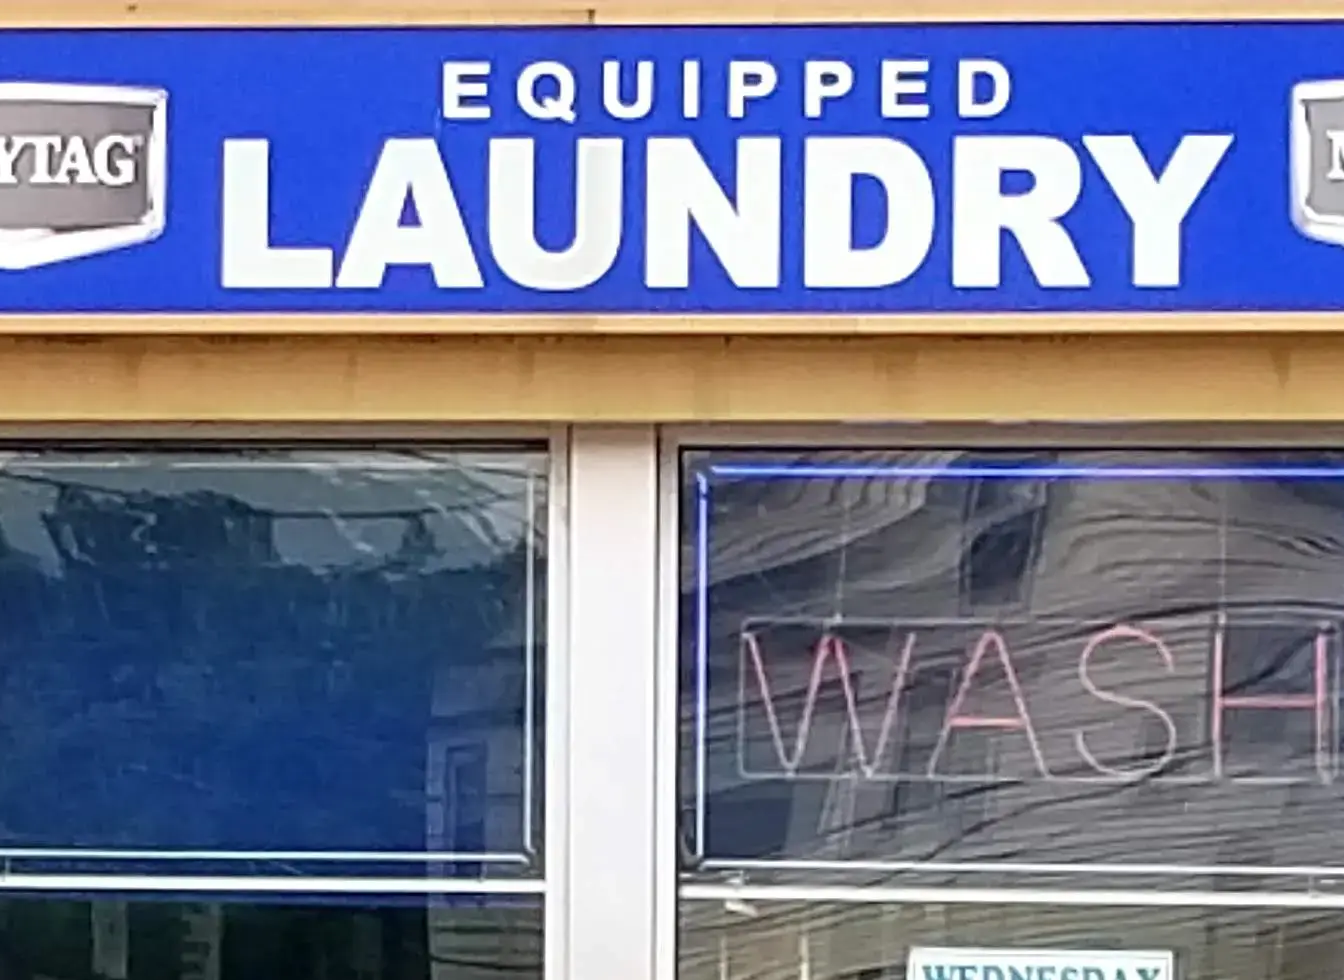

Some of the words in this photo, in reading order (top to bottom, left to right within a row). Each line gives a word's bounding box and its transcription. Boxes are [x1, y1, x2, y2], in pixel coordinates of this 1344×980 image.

[442, 59, 1013, 123] EQUIPPED
[221, 134, 1236, 291] LAUNDRY
[741, 622, 1324, 778] WASH
